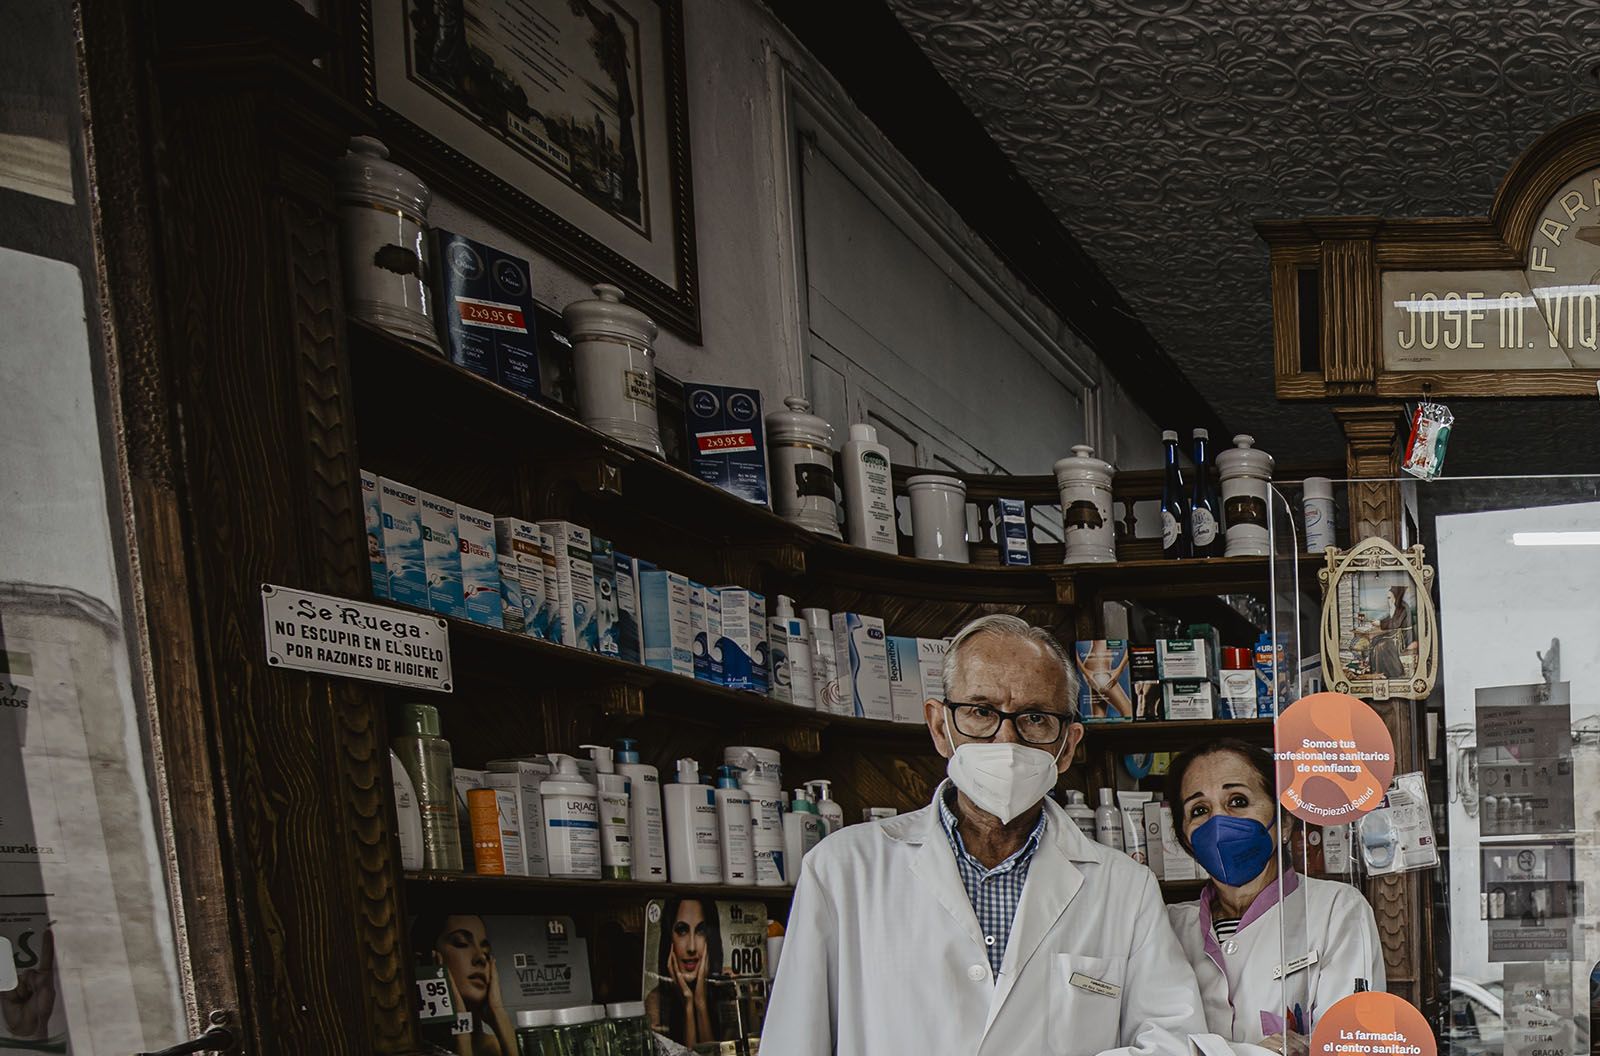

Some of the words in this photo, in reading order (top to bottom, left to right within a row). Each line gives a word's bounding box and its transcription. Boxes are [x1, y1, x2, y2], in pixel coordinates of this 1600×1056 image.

[1397, 291, 1486, 351] JOSE
[297, 599, 333, 620] Se
[336, 604, 421, 639] Ruega
[275, 620, 295, 637] NO
[301, 624, 361, 648] ESCUPIR
[364, 636, 381, 651] EN
[385, 639, 402, 655] EL
[403, 643, 443, 663] SUELO
[286, 643, 313, 659] POR
[317, 647, 373, 669] RAZONES
[377, 657, 391, 672] DE
[394, 660, 439, 680] HIGIENE
[886, 639, 899, 682] Bepanthol
[1302, 739, 1337, 749] Somos
[1338, 739, 1356, 749] tus
[1273, 751, 1337, 761] rofesionales
[1338, 751, 1390, 761] sanitarios
[1296, 764, 1310, 773] de
[1311, 763, 1362, 773] confianza
[730, 904, 743, 920] th
[548, 919, 565, 935] th
[731, 948, 763, 975] ORO
[515, 966, 564, 983] VITALIA
[1340, 1029, 1354, 1041] La
[1355, 1030, 1407, 1043] farmacia,
[1323, 1043, 1334, 1052] el
[1335, 1044, 1371, 1054] centro
[1372, 1043, 1421, 1055] sanitario
